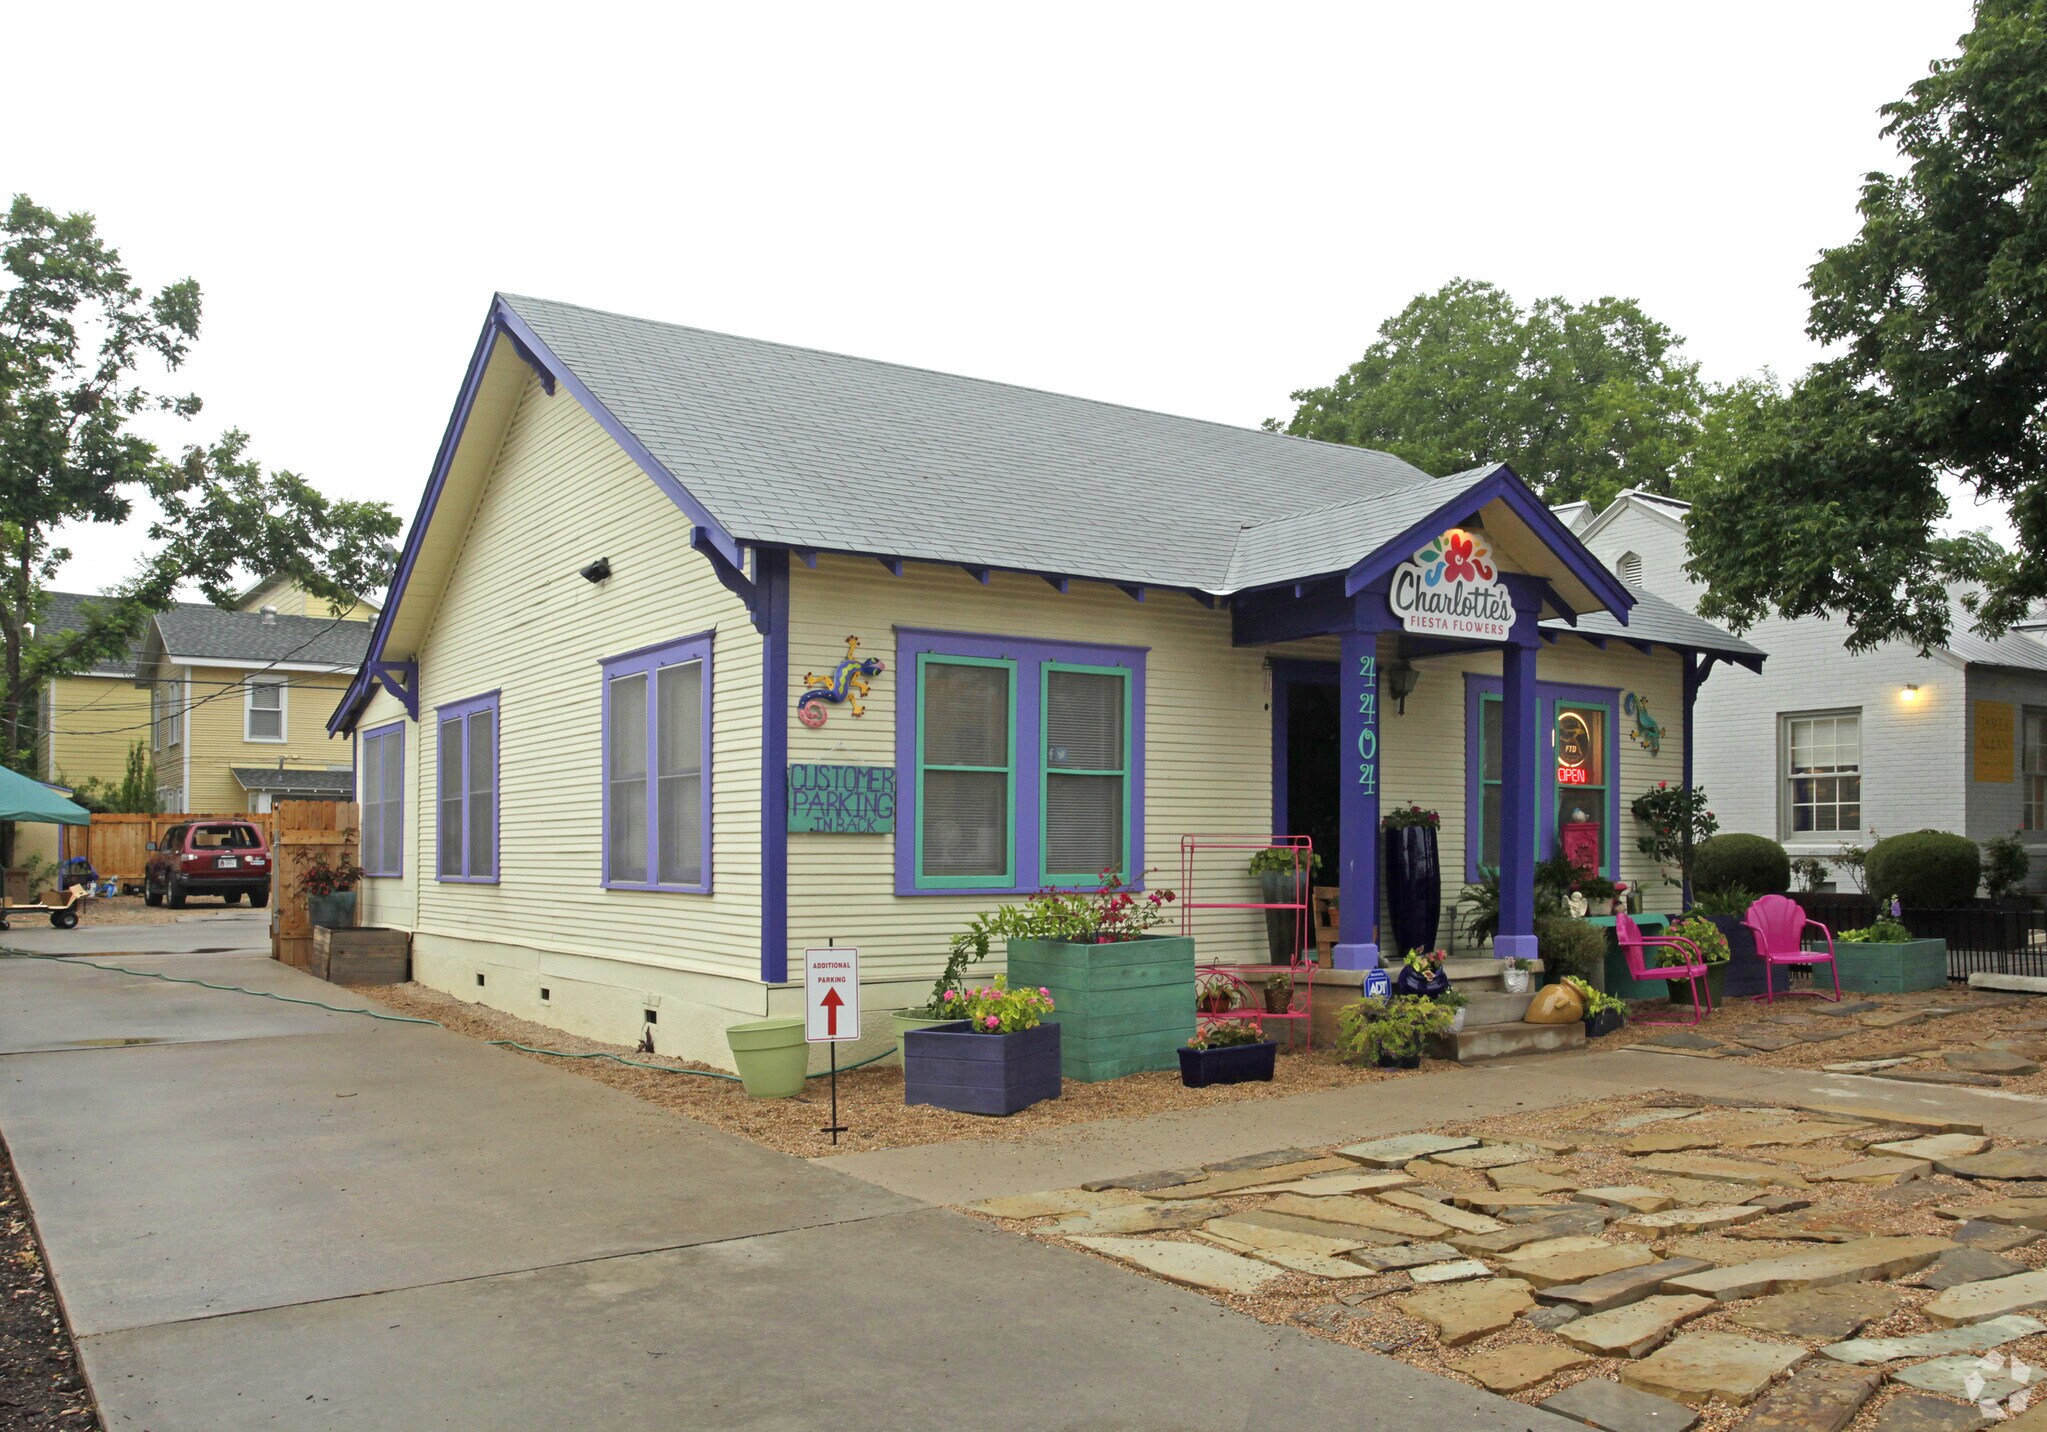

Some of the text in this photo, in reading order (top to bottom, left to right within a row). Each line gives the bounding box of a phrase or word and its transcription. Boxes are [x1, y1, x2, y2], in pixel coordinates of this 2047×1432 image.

[1396, 570, 1511, 621] Charlotte's
[1410, 615, 1504, 635] FIESTA FLOWERS
[1358, 655, 1376, 795] 4404
[1565, 744, 1577, 753] FTD
[791, 764, 895, 792] CUSTOMER
[1557, 767, 1586, 783] OPEN
[793, 791, 894, 819] PARKING
[814, 817, 877, 833] IN BACK
[1370, 980, 1387, 995] ADT
